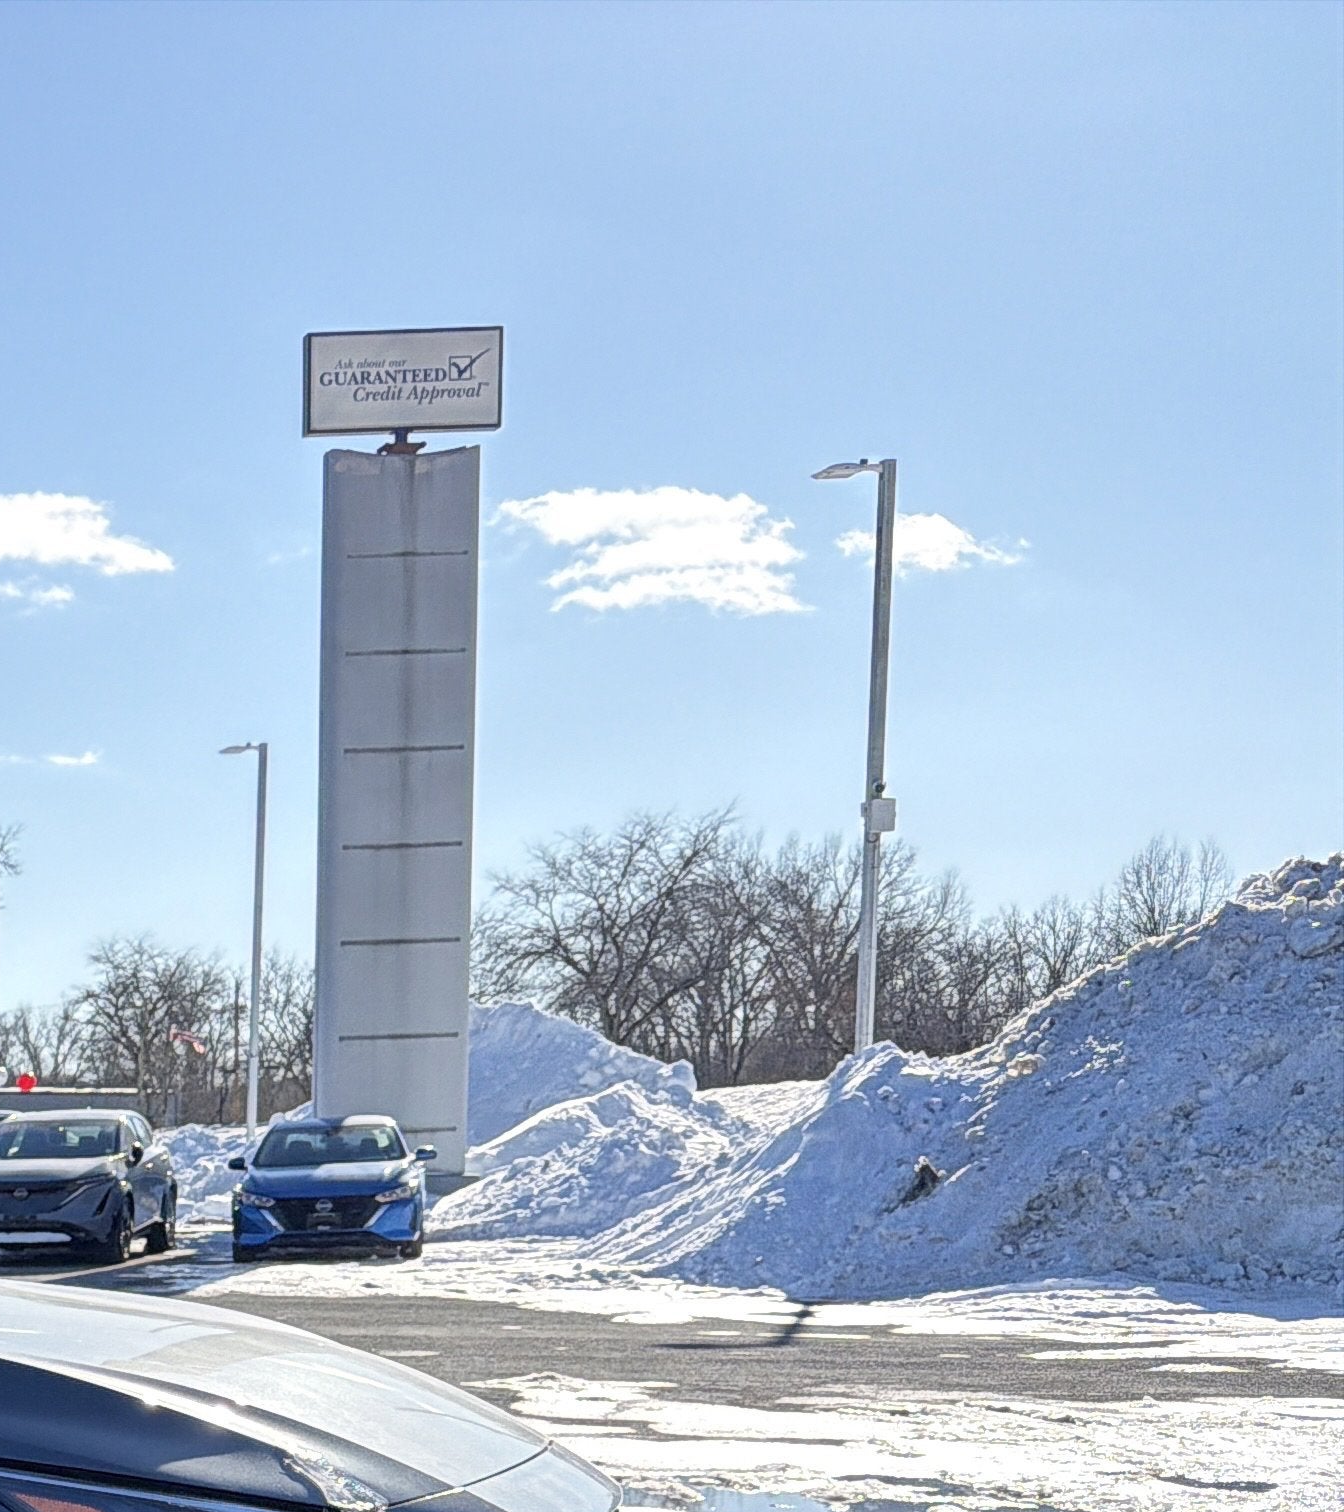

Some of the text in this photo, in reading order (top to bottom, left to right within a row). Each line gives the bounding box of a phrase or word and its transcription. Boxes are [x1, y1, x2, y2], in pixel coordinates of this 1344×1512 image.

[334, 358, 408, 370] Ask about our
[319, 367, 448, 387] GUARANTEED
[352, 386, 403, 402] Credit
